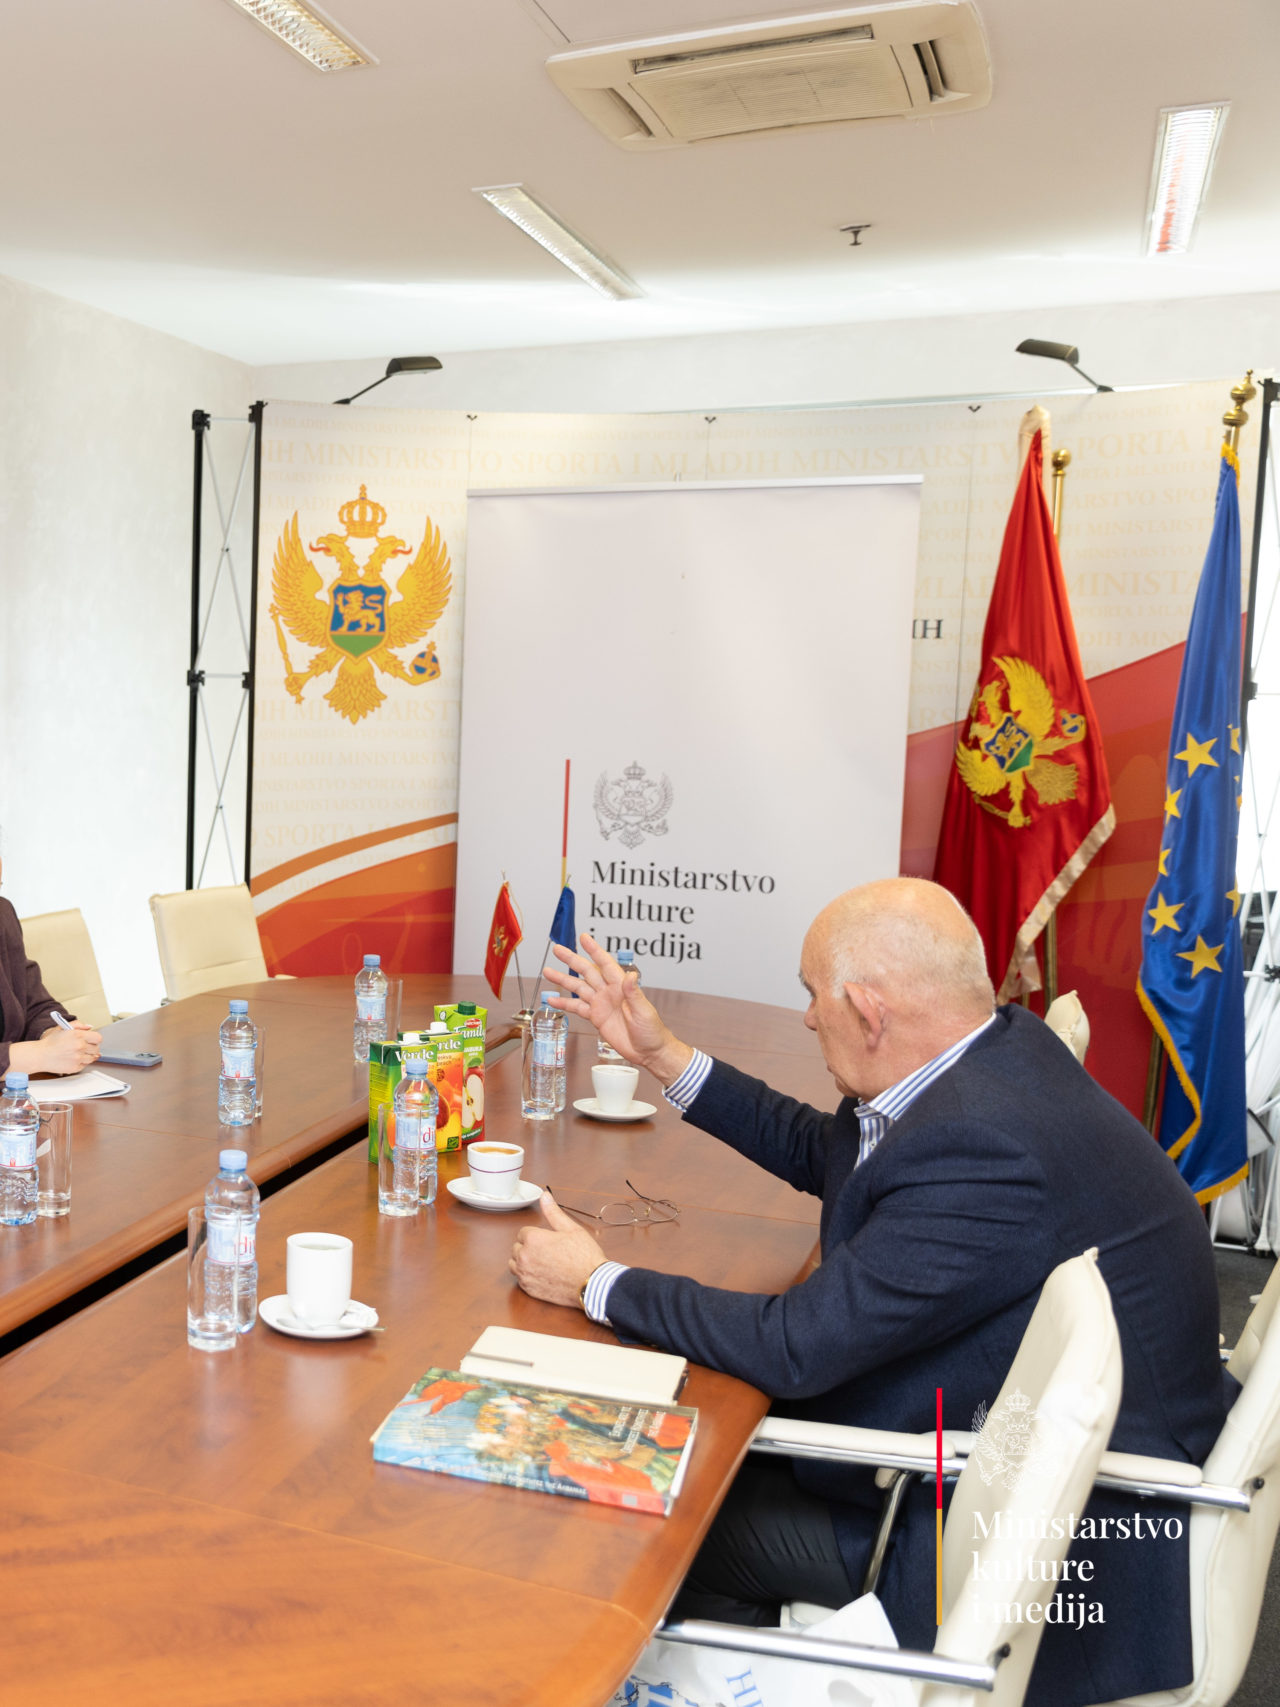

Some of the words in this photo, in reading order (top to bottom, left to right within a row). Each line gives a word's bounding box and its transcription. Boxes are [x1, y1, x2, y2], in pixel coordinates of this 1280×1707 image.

[304, 441, 503, 474] MINISTARSTVO
[511, 449, 624, 475] SPORTA
[631, 451, 641, 475] I
[649, 449, 784, 475] MLADIH
[792, 440, 1018, 474] MINISTARSTV
[591, 860, 776, 894] Ministarstvo
[589, 893, 695, 924] kulture
[606, 932, 703, 964] medija
[395, 1048, 434, 1062] Verde
